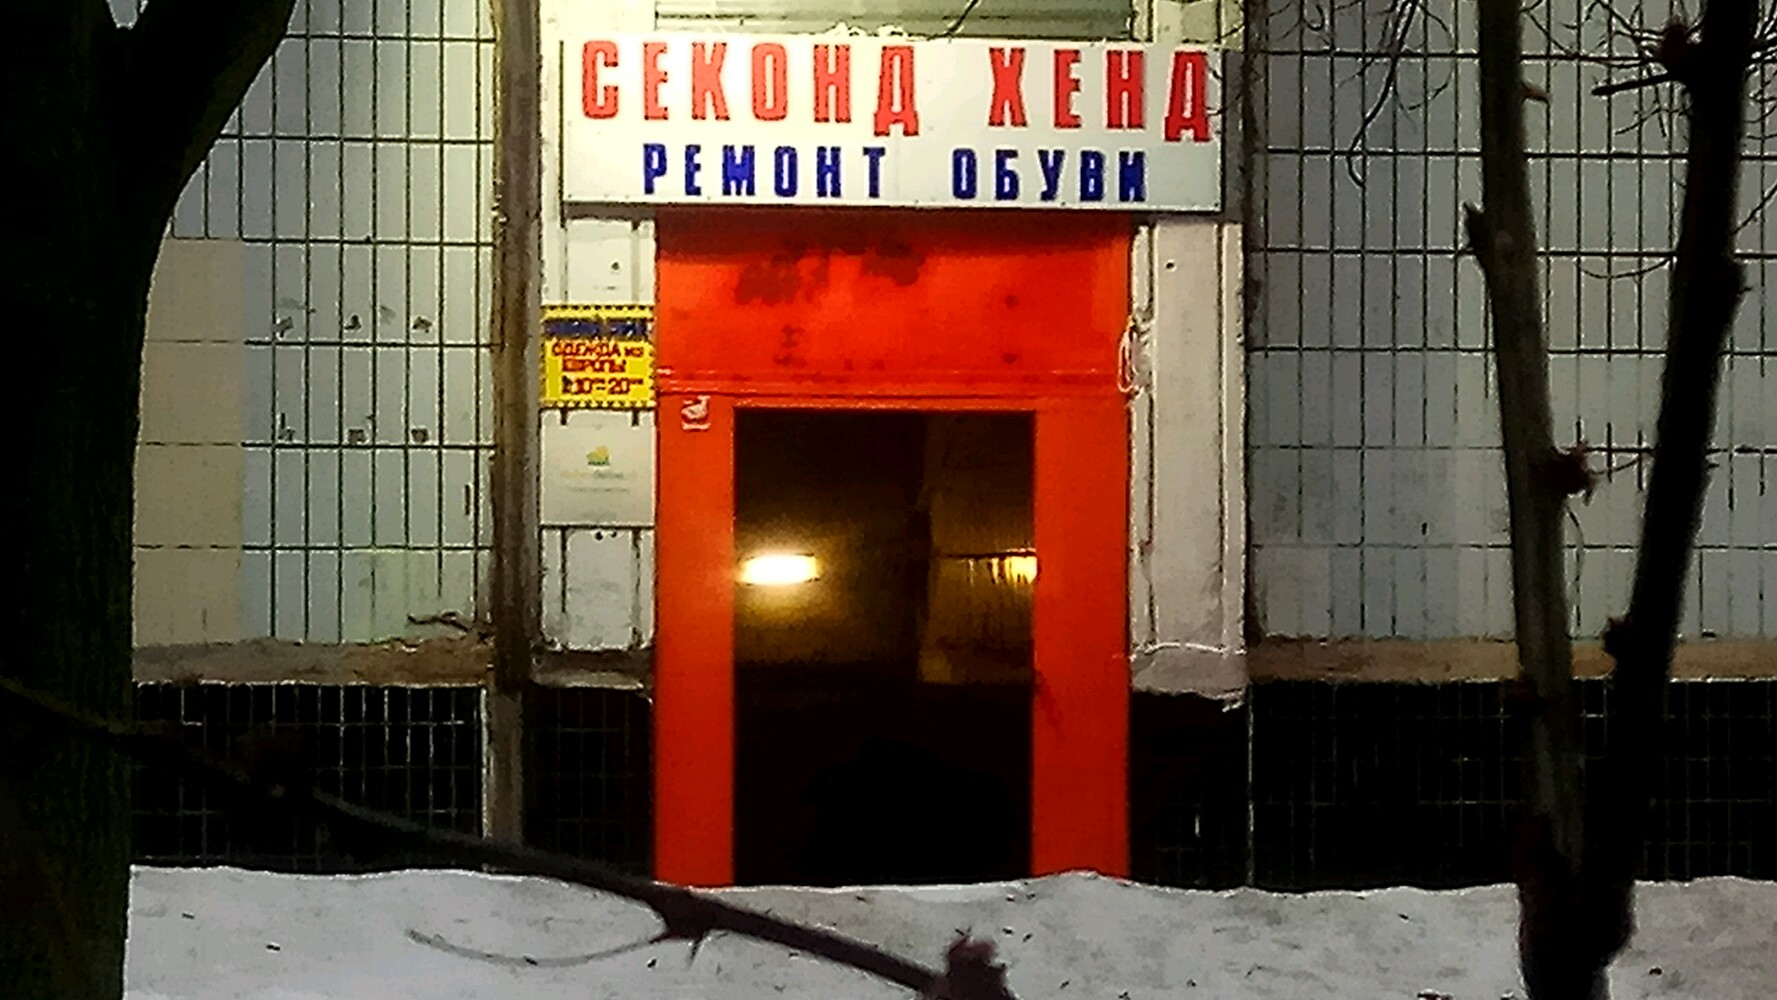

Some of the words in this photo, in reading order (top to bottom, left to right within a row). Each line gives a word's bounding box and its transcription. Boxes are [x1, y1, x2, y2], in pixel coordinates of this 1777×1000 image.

[581, 39, 920, 137] СЕКОНД
[988, 46, 1211, 143] ХЕНД
[643, 143, 886, 198] РЕМОНТ
[952, 147, 1147, 202] ОБУВИ
